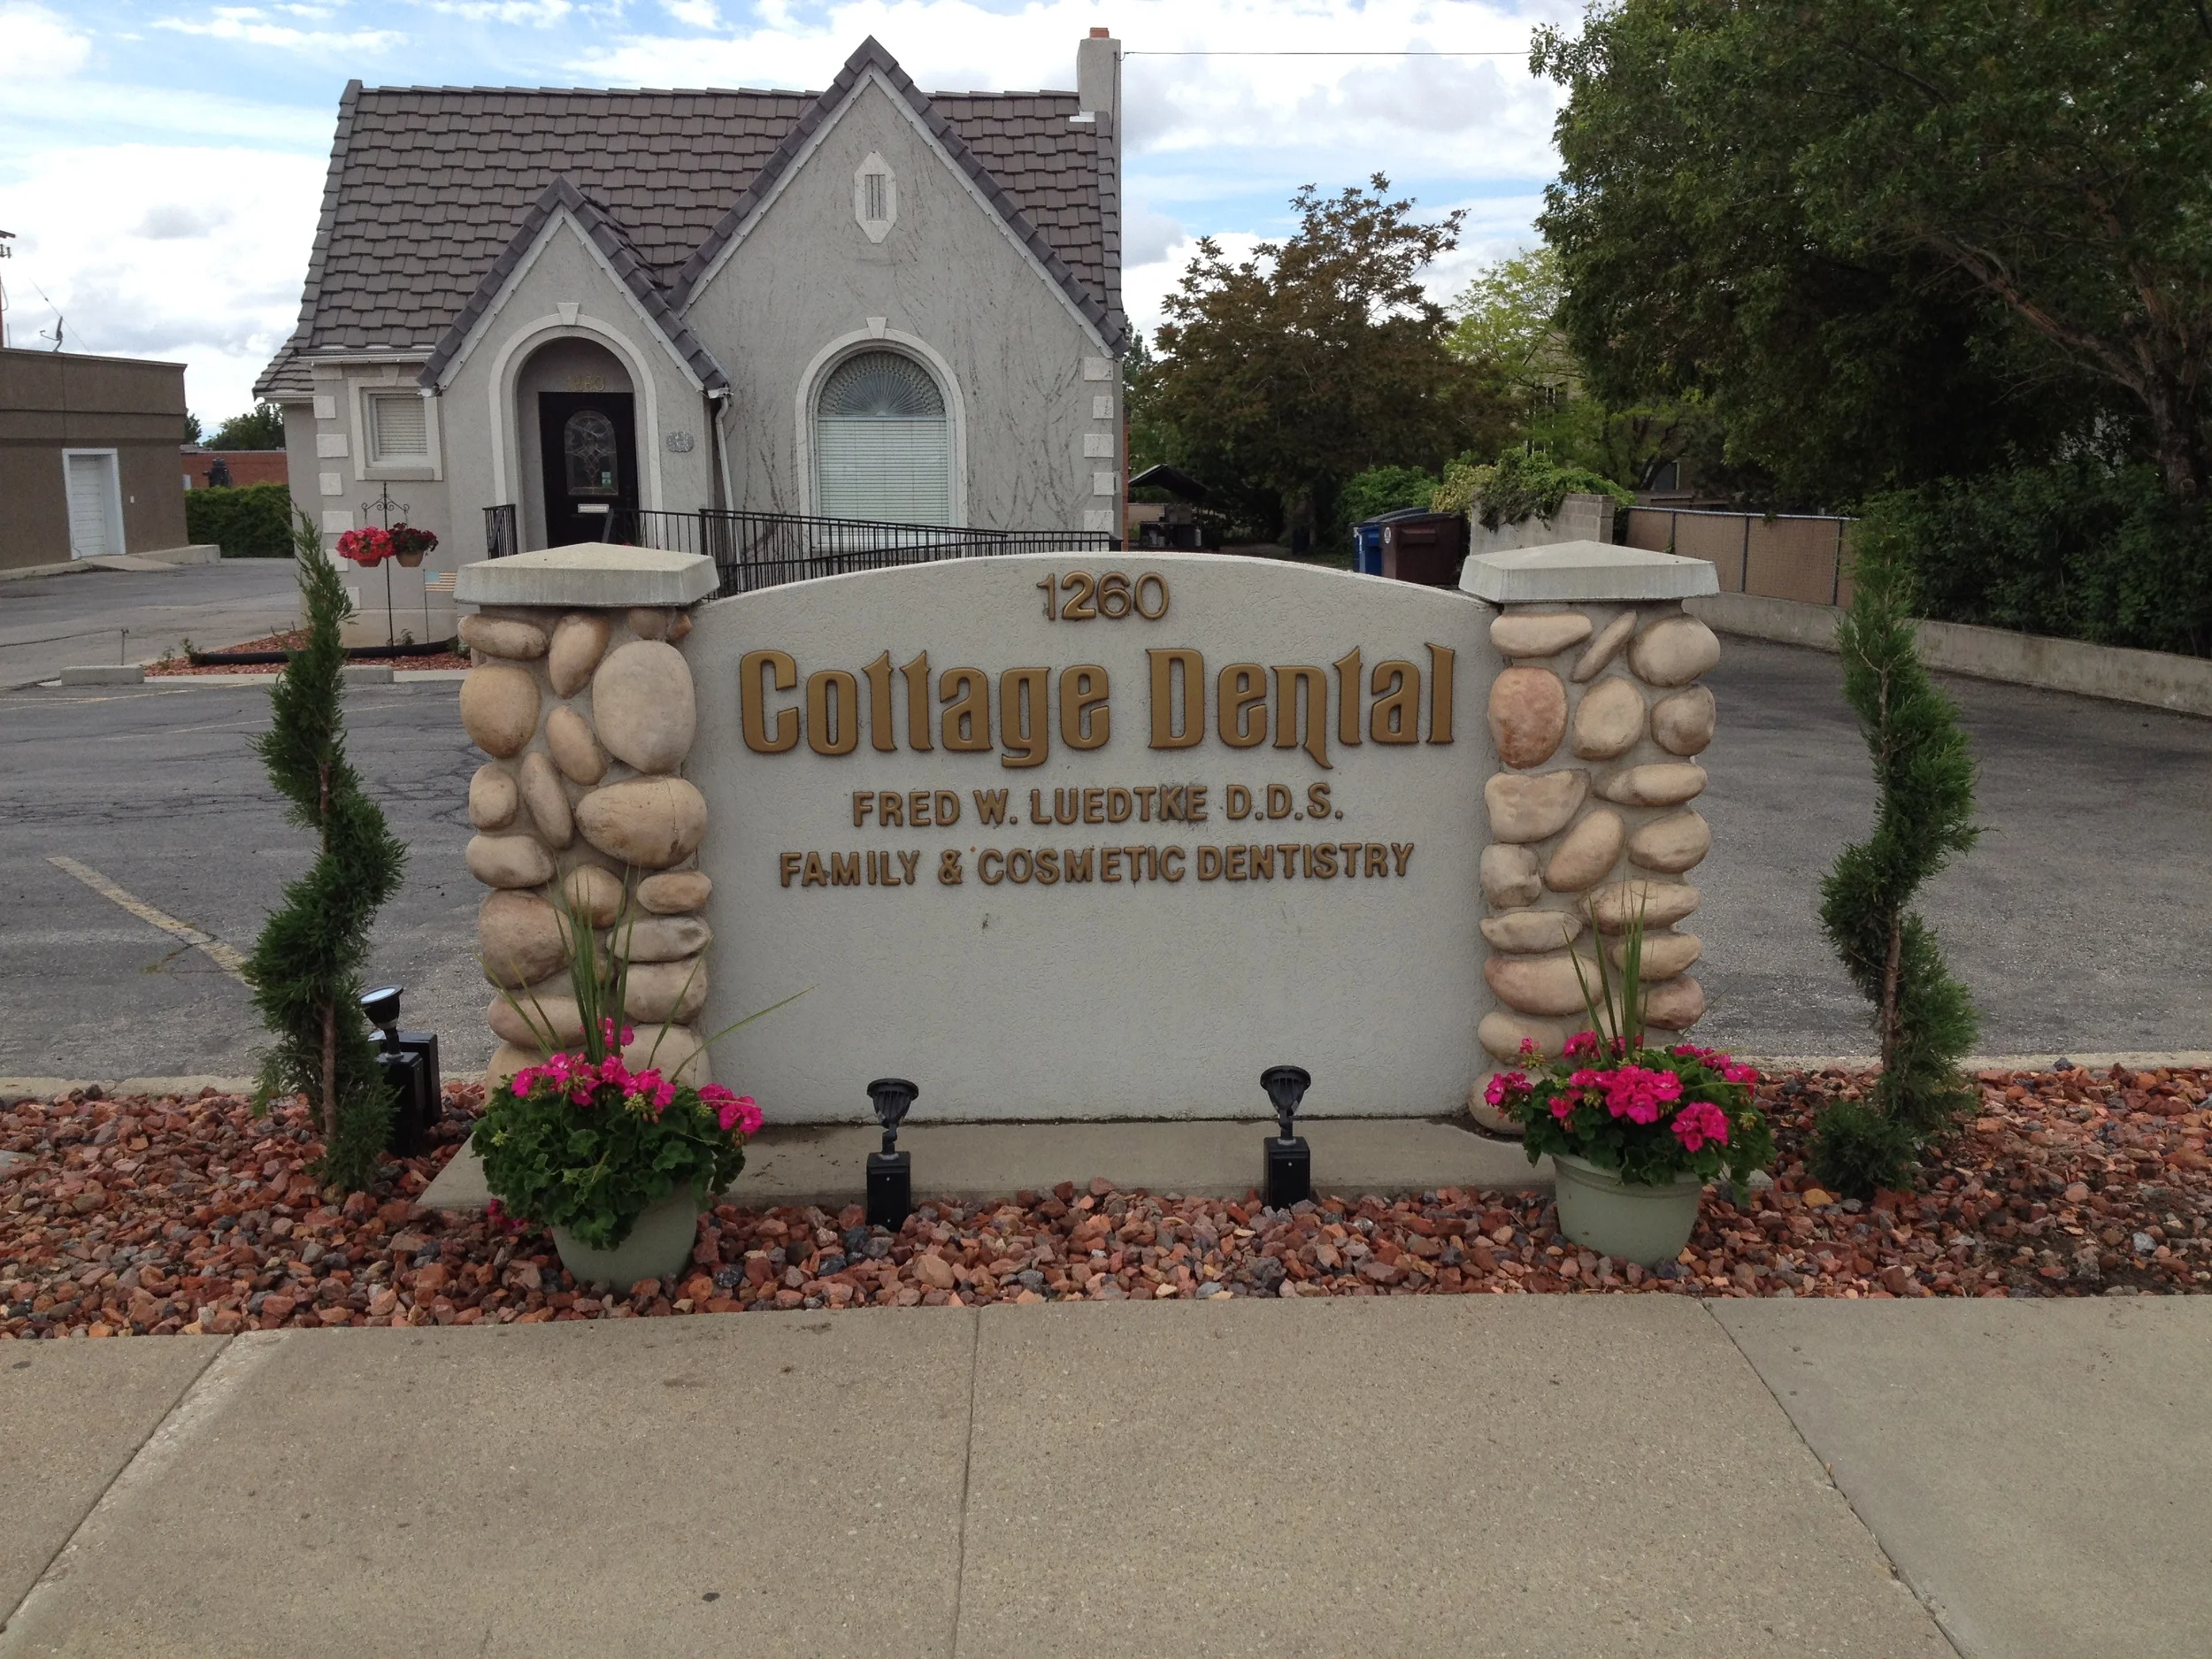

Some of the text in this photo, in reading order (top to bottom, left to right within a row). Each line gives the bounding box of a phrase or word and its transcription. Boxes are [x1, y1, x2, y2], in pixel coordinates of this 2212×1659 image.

[1036, 571, 1171, 621] 1260
[739, 642, 1456, 771] Cottage Dental
[852, 783, 1345, 827] FRED W. LUEDTKE D.D.S.
[780, 842, 1415, 887] FAMILY & COSMETIC DENTISTRY
